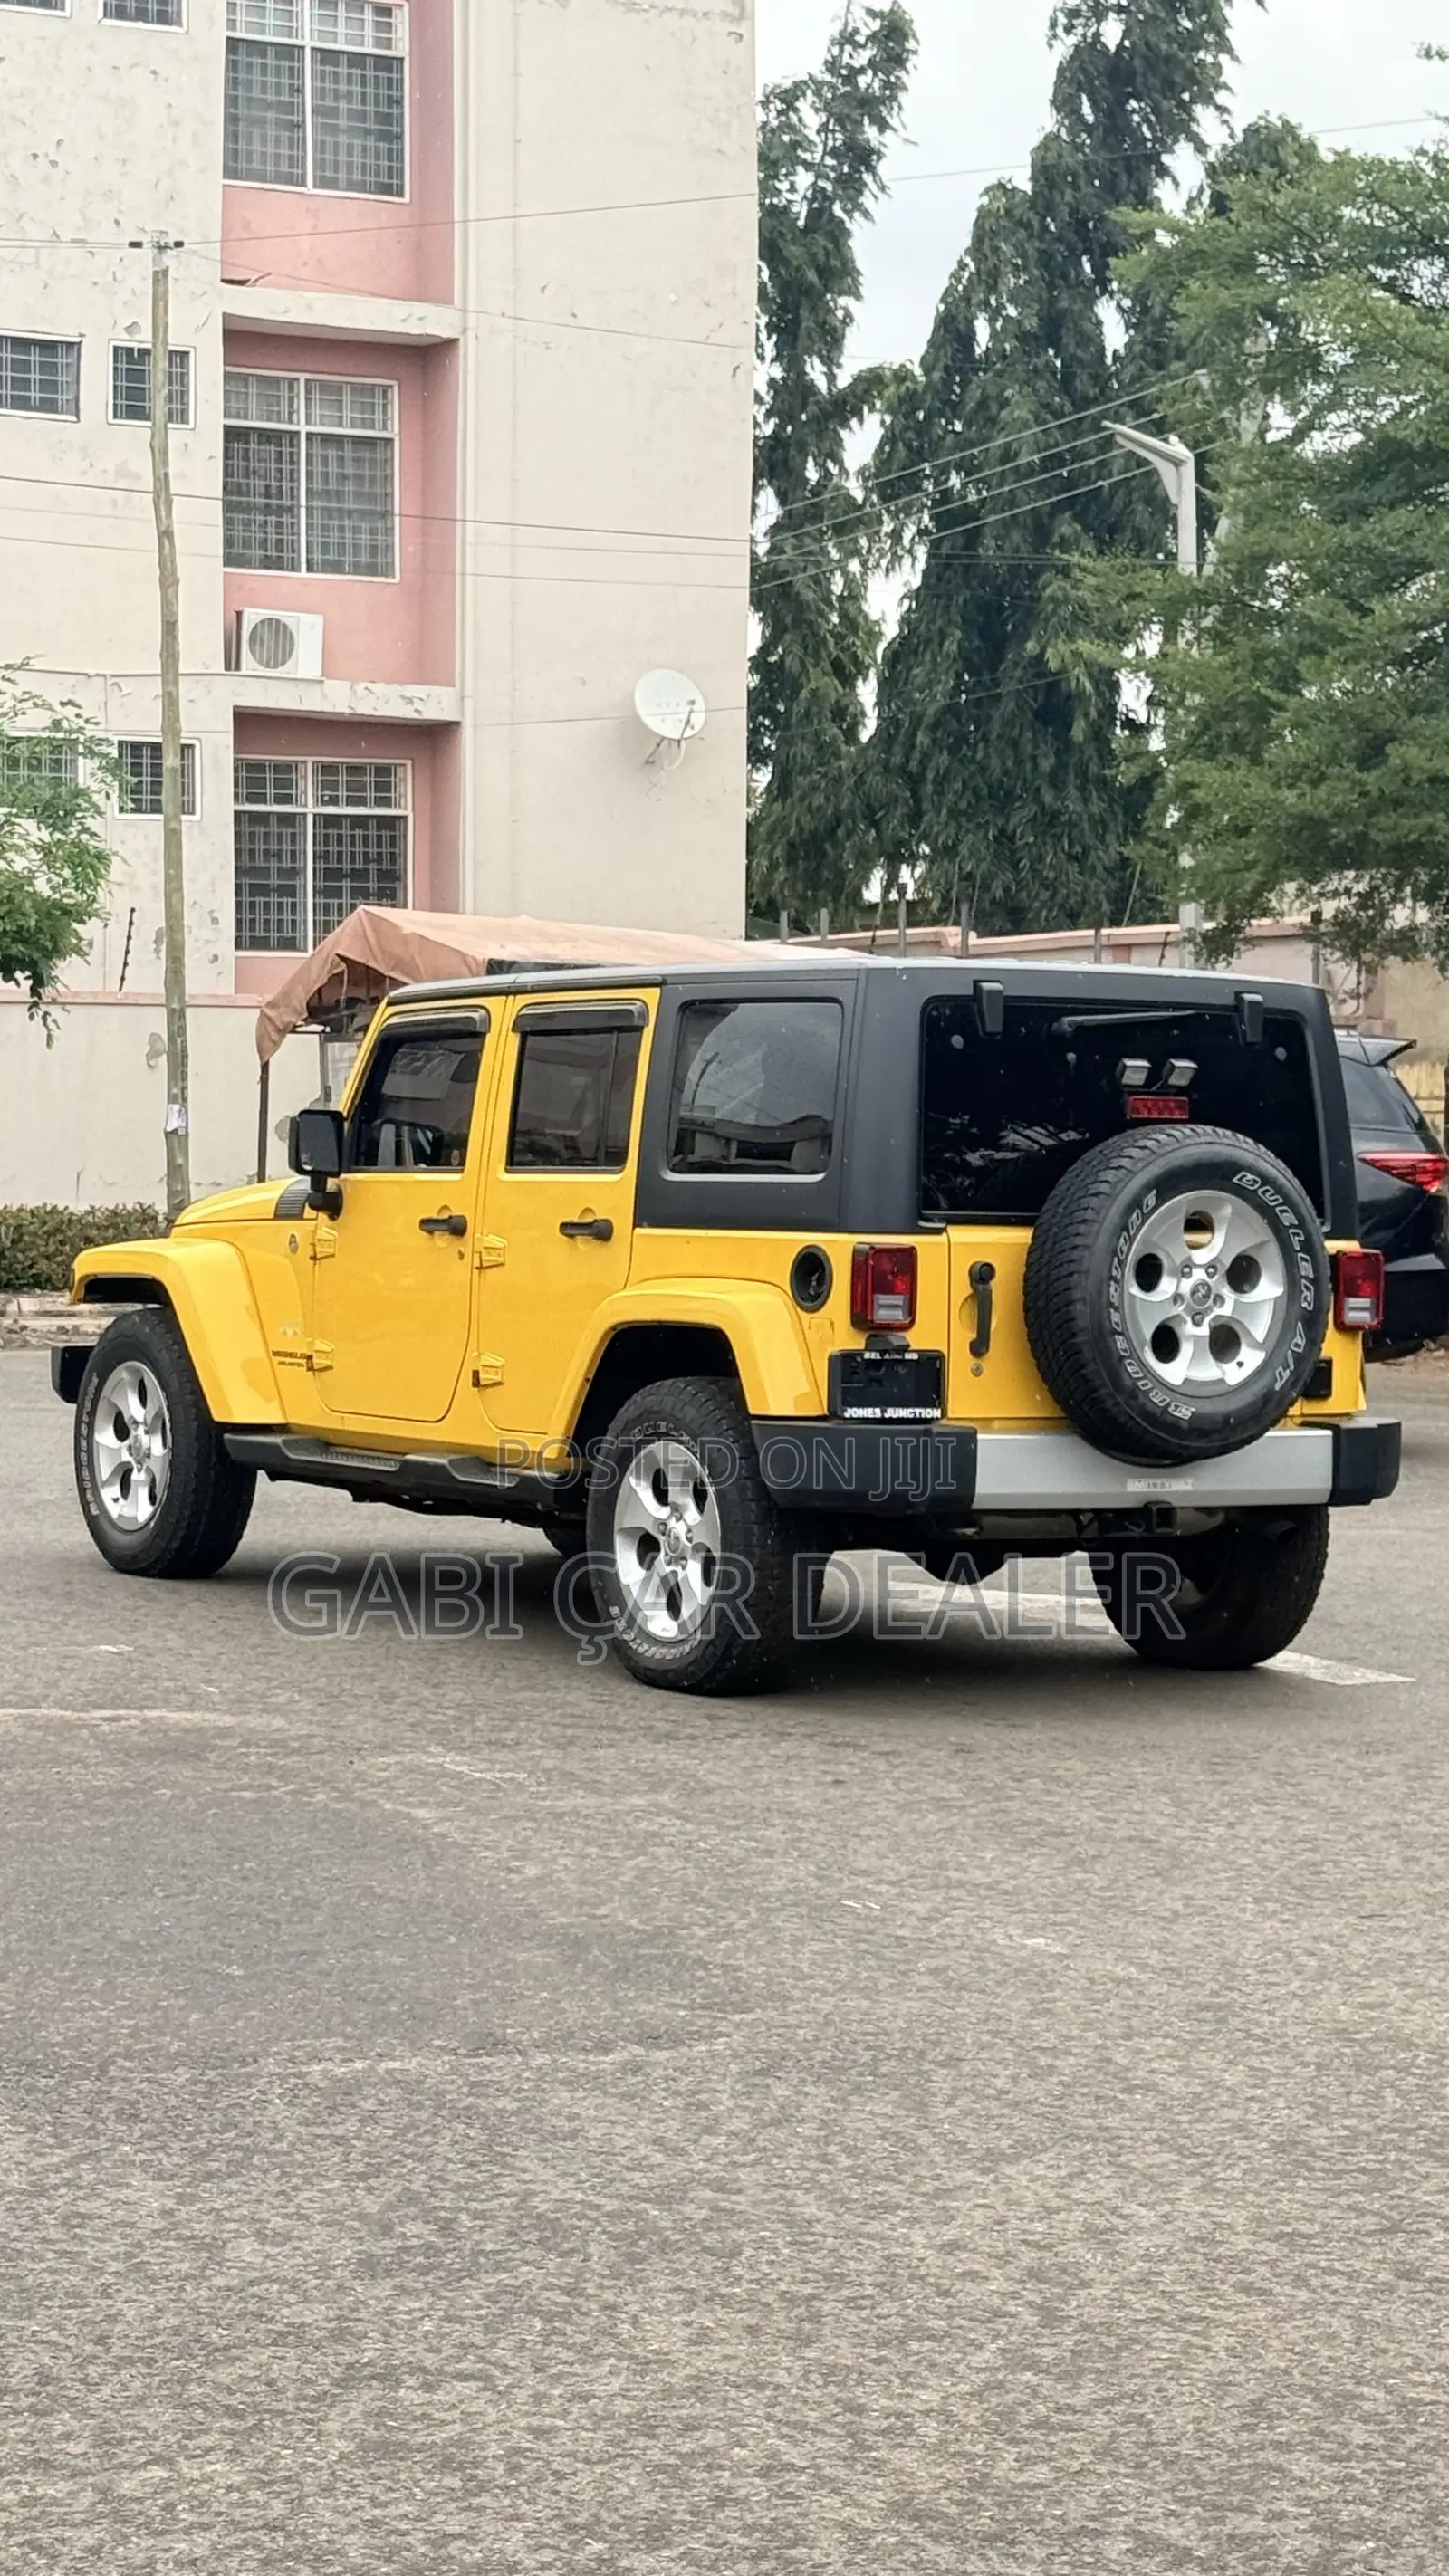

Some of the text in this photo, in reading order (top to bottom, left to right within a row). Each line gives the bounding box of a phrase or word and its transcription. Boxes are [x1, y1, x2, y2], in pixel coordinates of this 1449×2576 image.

[1108, 1188, 1196, 1422] BRIDGESTONE
[1232, 1170, 1316, 1393] DUELER A/T
[843, 1407, 942, 1419] JONES JUNCTION
